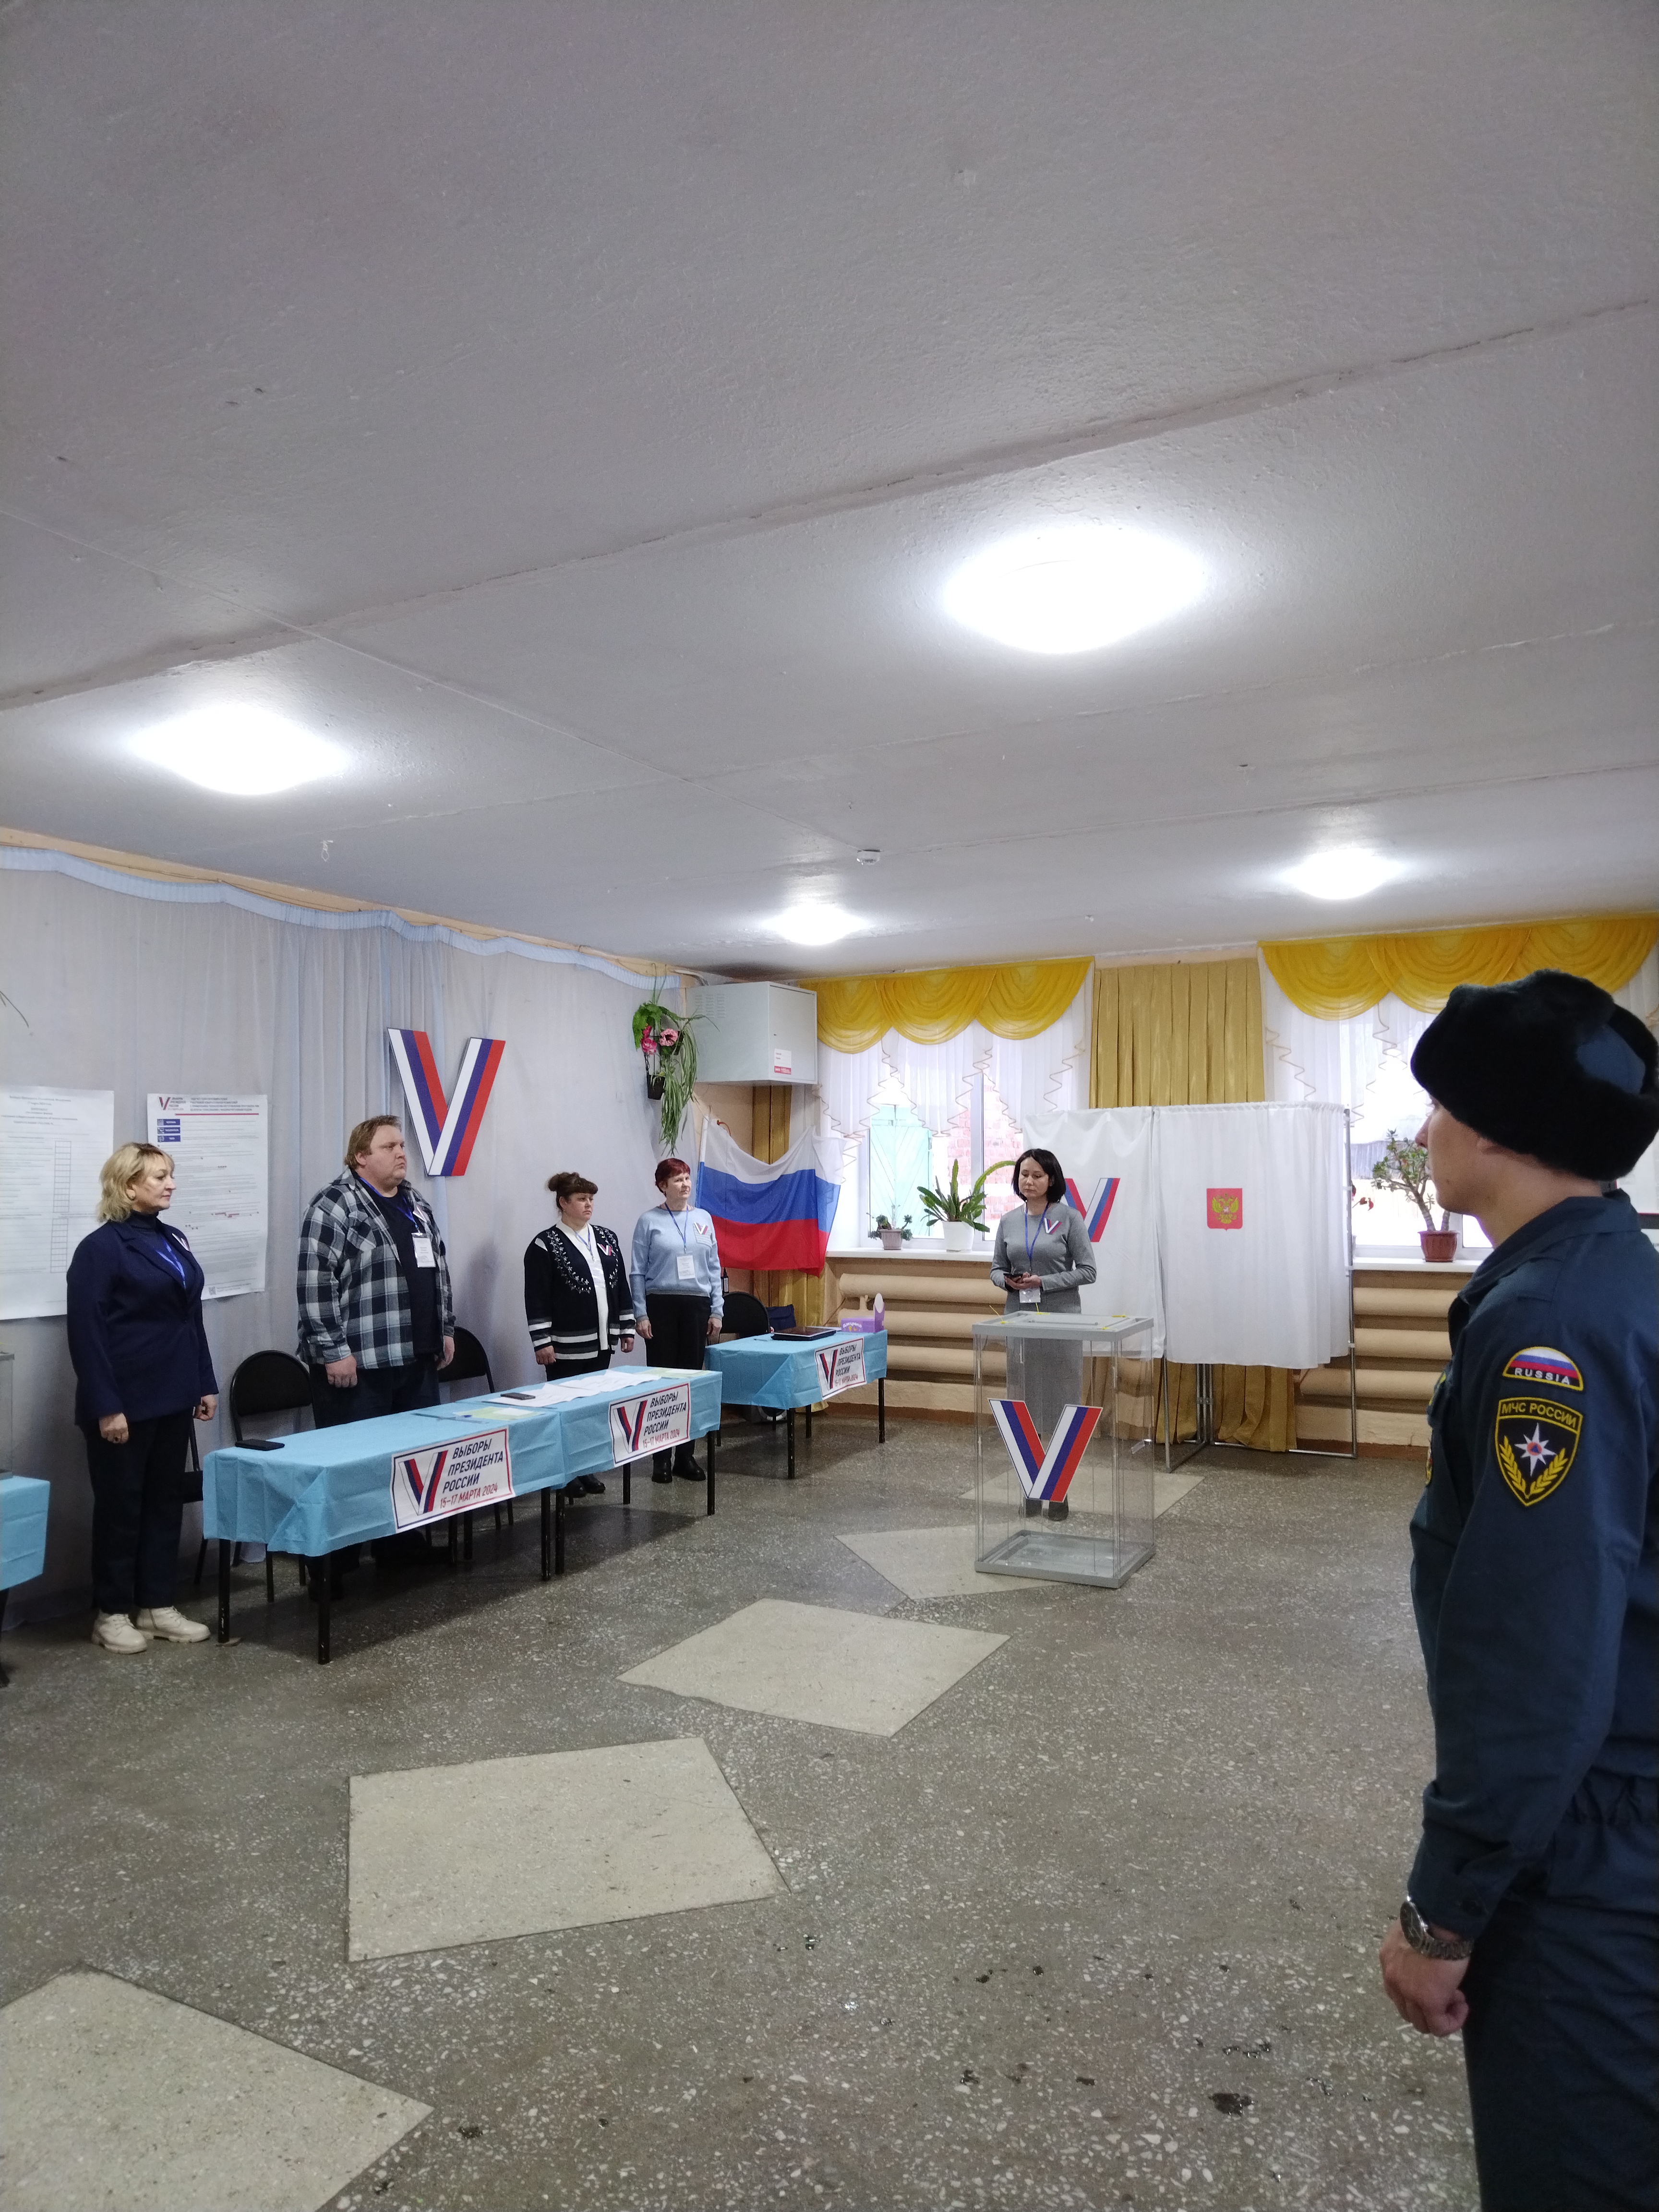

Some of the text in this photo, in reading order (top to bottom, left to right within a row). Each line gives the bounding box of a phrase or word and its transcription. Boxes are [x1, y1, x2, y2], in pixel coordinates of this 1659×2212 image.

[1514, 1368, 1570, 1385] RUSSIA
[650, 1391, 678, 1408] ВЫБОРЫ
[647, 1402, 686, 1422] ПРЕЗИДЕНТА
[1501, 1402, 1577, 1429] МЧС РОССИИ
[644, 1419, 669, 1436] РОССИИ
[655, 1432, 669, 1444] МАРТА
[670, 1428, 680, 1439] 2024
[452, 1439, 493, 1460] ВЫБОРЫ
[447, 1451, 504, 1477] ПРЕЗИДЕНТА
[443, 1472, 481, 1494] РОССИИ
[457, 1487, 482, 1504] МАРТА
[482, 1482, 498, 1497] 2024
